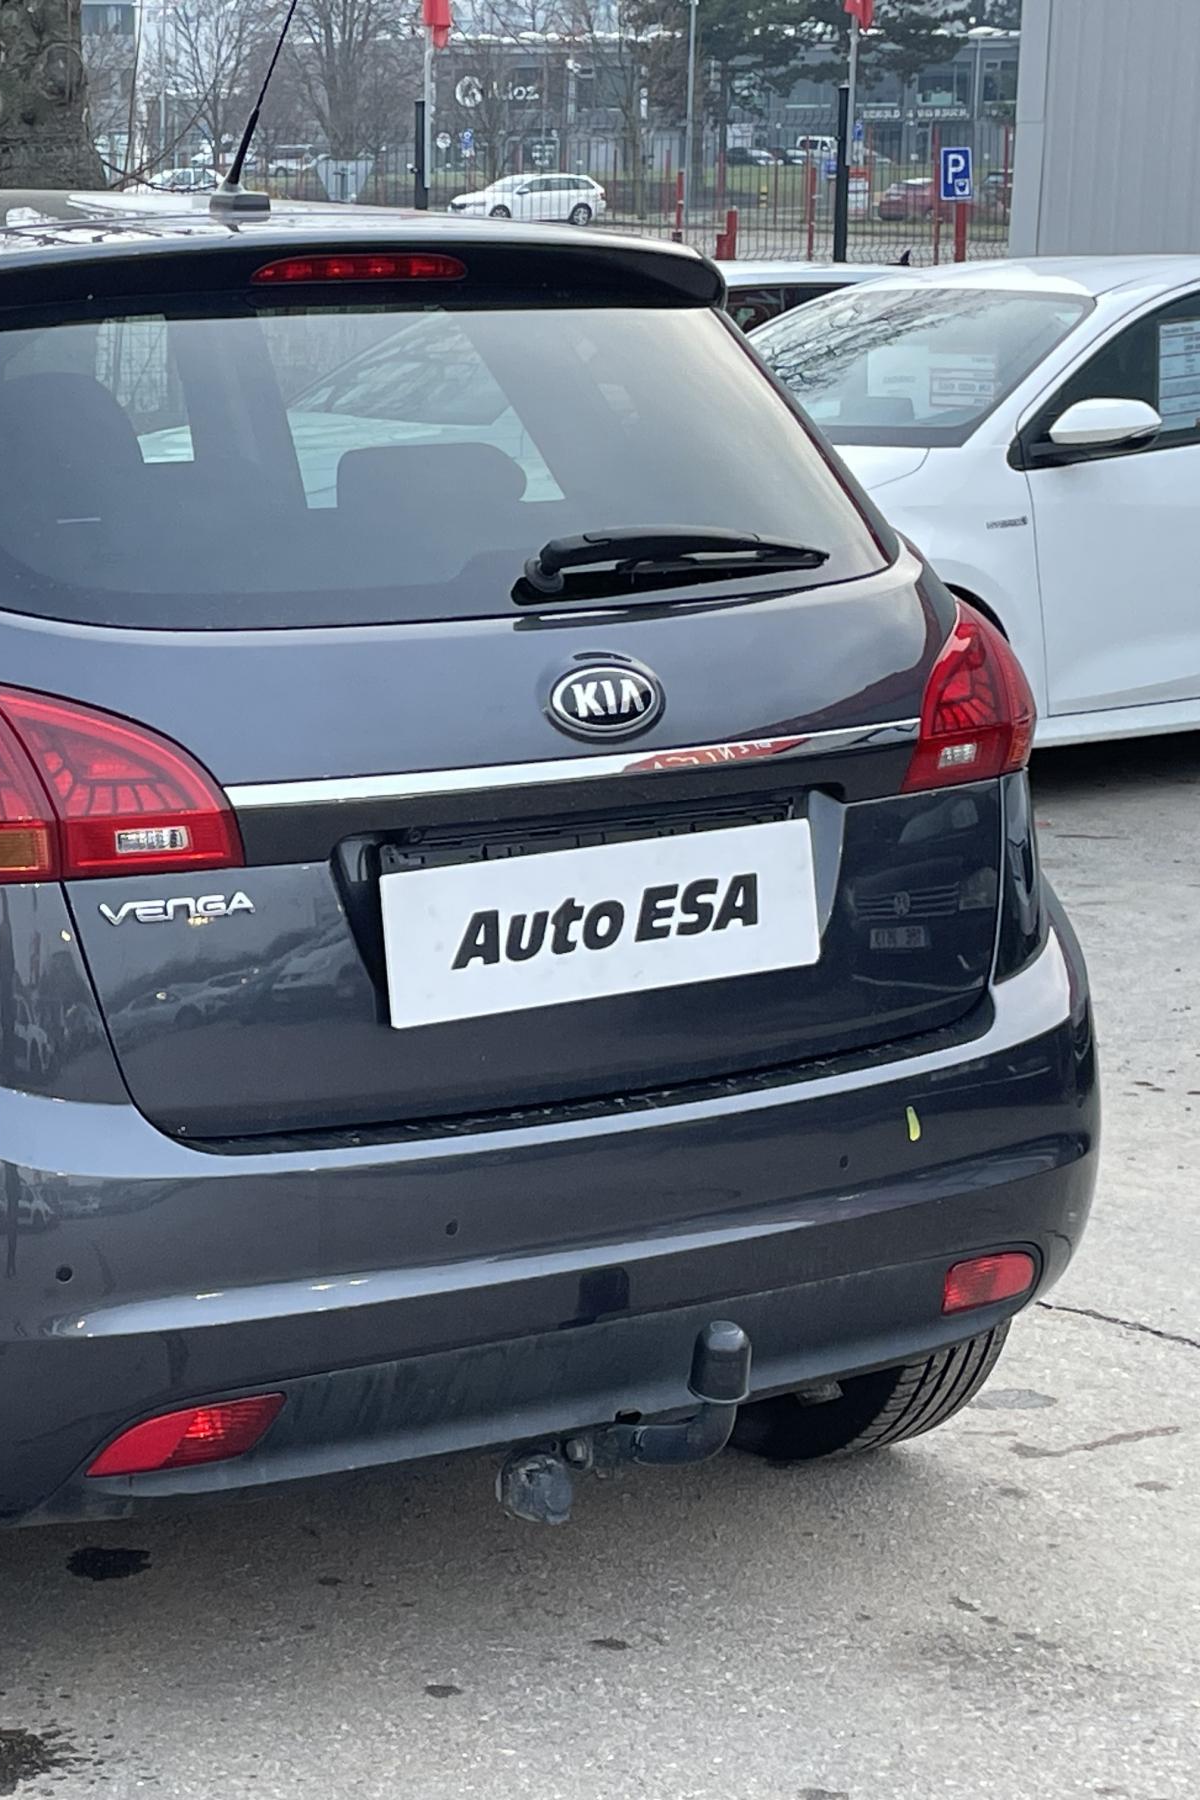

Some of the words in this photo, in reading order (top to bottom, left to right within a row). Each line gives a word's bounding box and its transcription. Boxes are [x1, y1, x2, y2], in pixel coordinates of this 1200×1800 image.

[947, 153, 966, 185] P
[571, 678, 645, 718] KIA
[99, 891, 256, 926] VENGA
[451, 897, 626, 970] Auto
[634, 872, 758, 943] ESA
